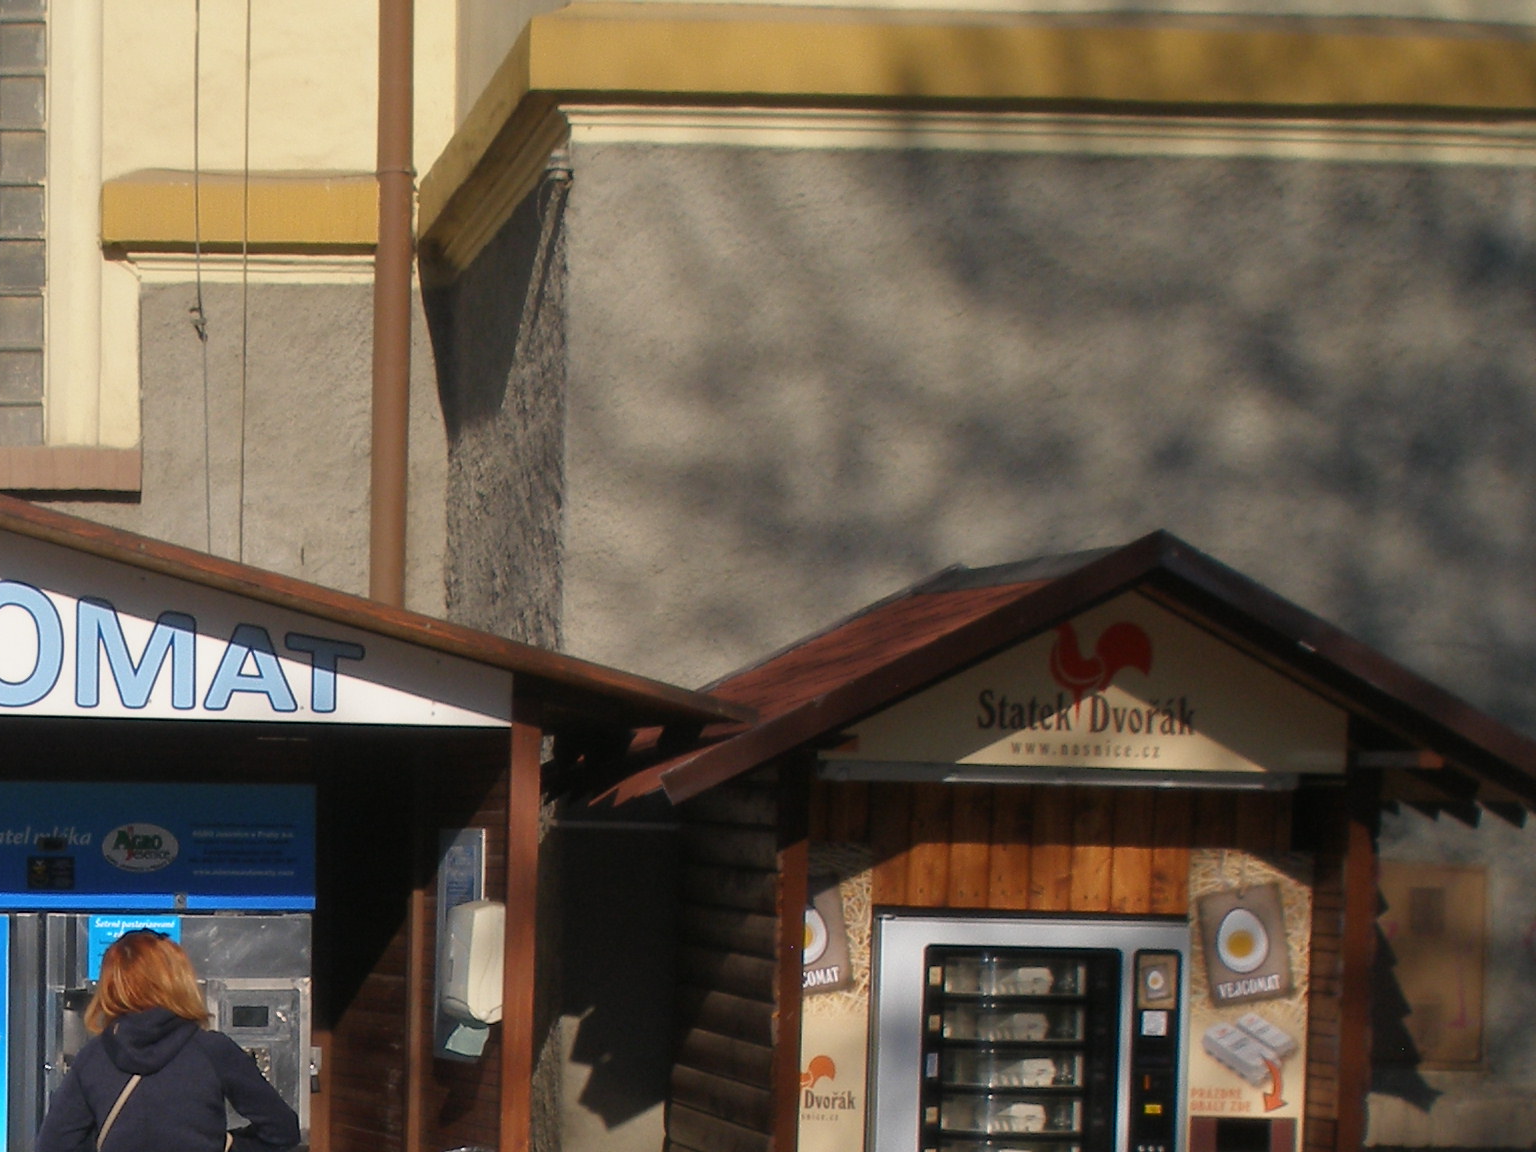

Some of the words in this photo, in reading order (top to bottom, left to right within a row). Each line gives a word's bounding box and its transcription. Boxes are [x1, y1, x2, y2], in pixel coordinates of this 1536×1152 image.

[977, 689, 1072, 731] Statek
[1089, 694, 1196, 736] Dvořák
[804, 1090, 857, 1110] Dvořák
